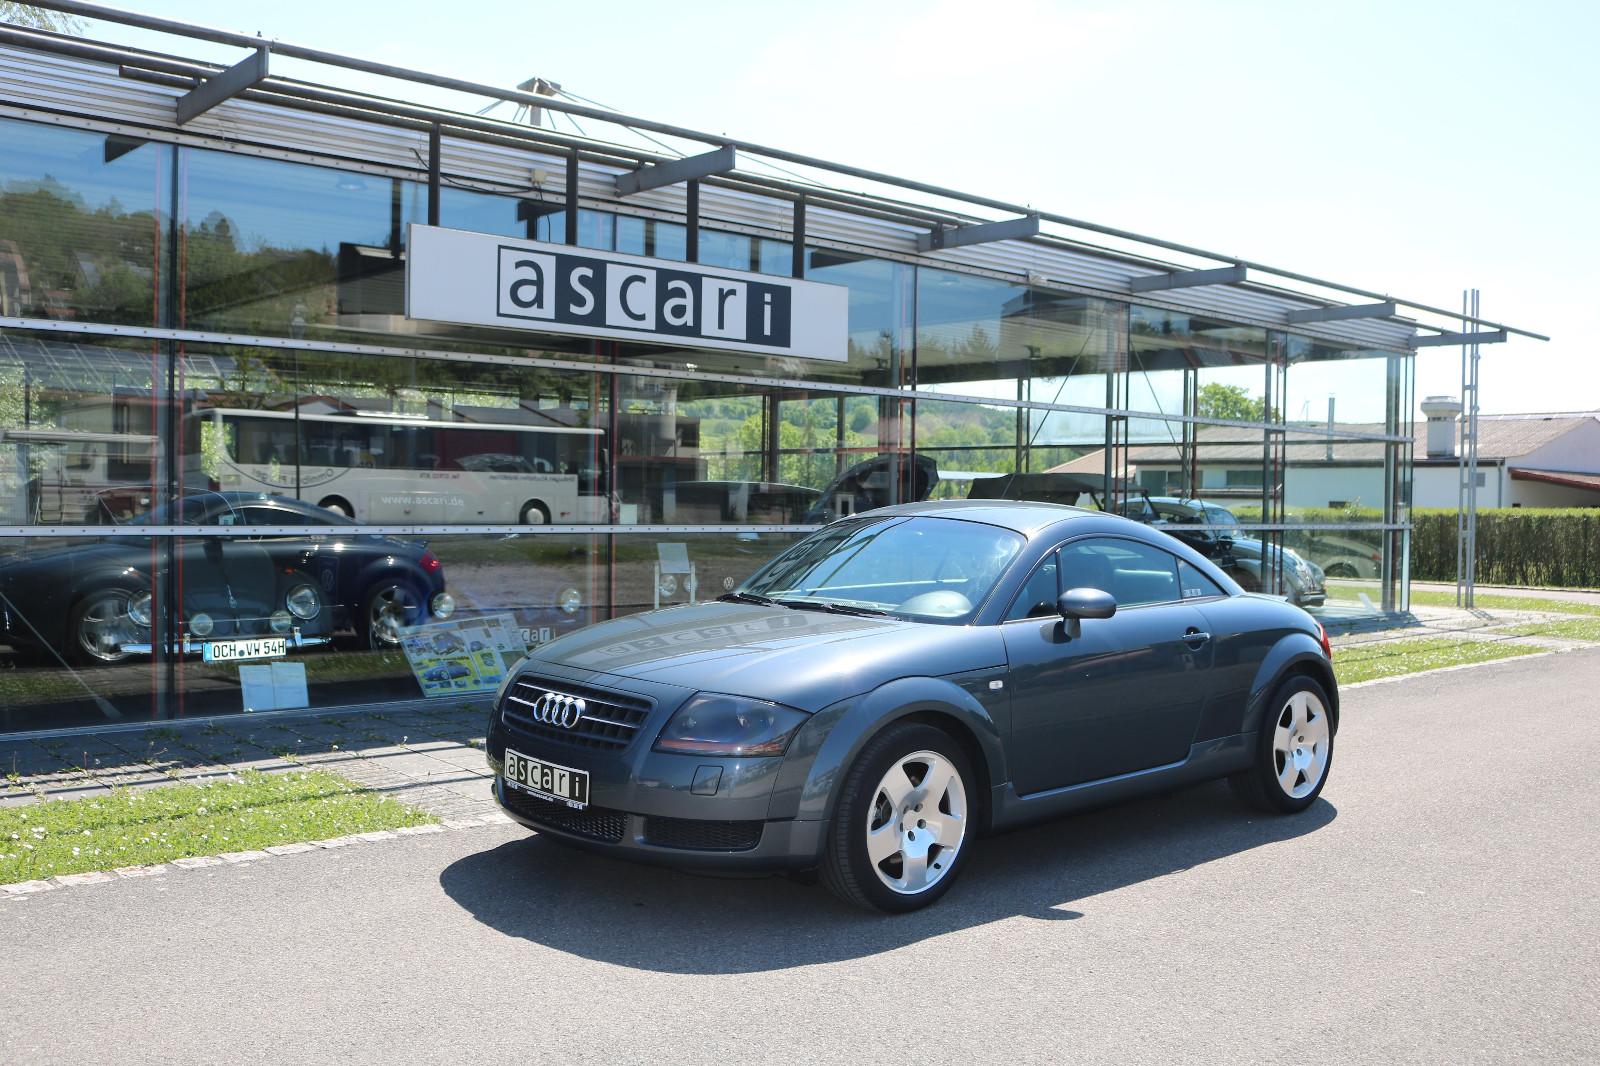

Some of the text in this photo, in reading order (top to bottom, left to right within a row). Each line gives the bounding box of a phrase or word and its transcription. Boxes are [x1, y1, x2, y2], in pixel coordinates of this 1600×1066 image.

[508, 258, 772, 337] ascari
[213, 640, 285, 658] OCH VW 54H
[508, 756, 579, 798] ascari
